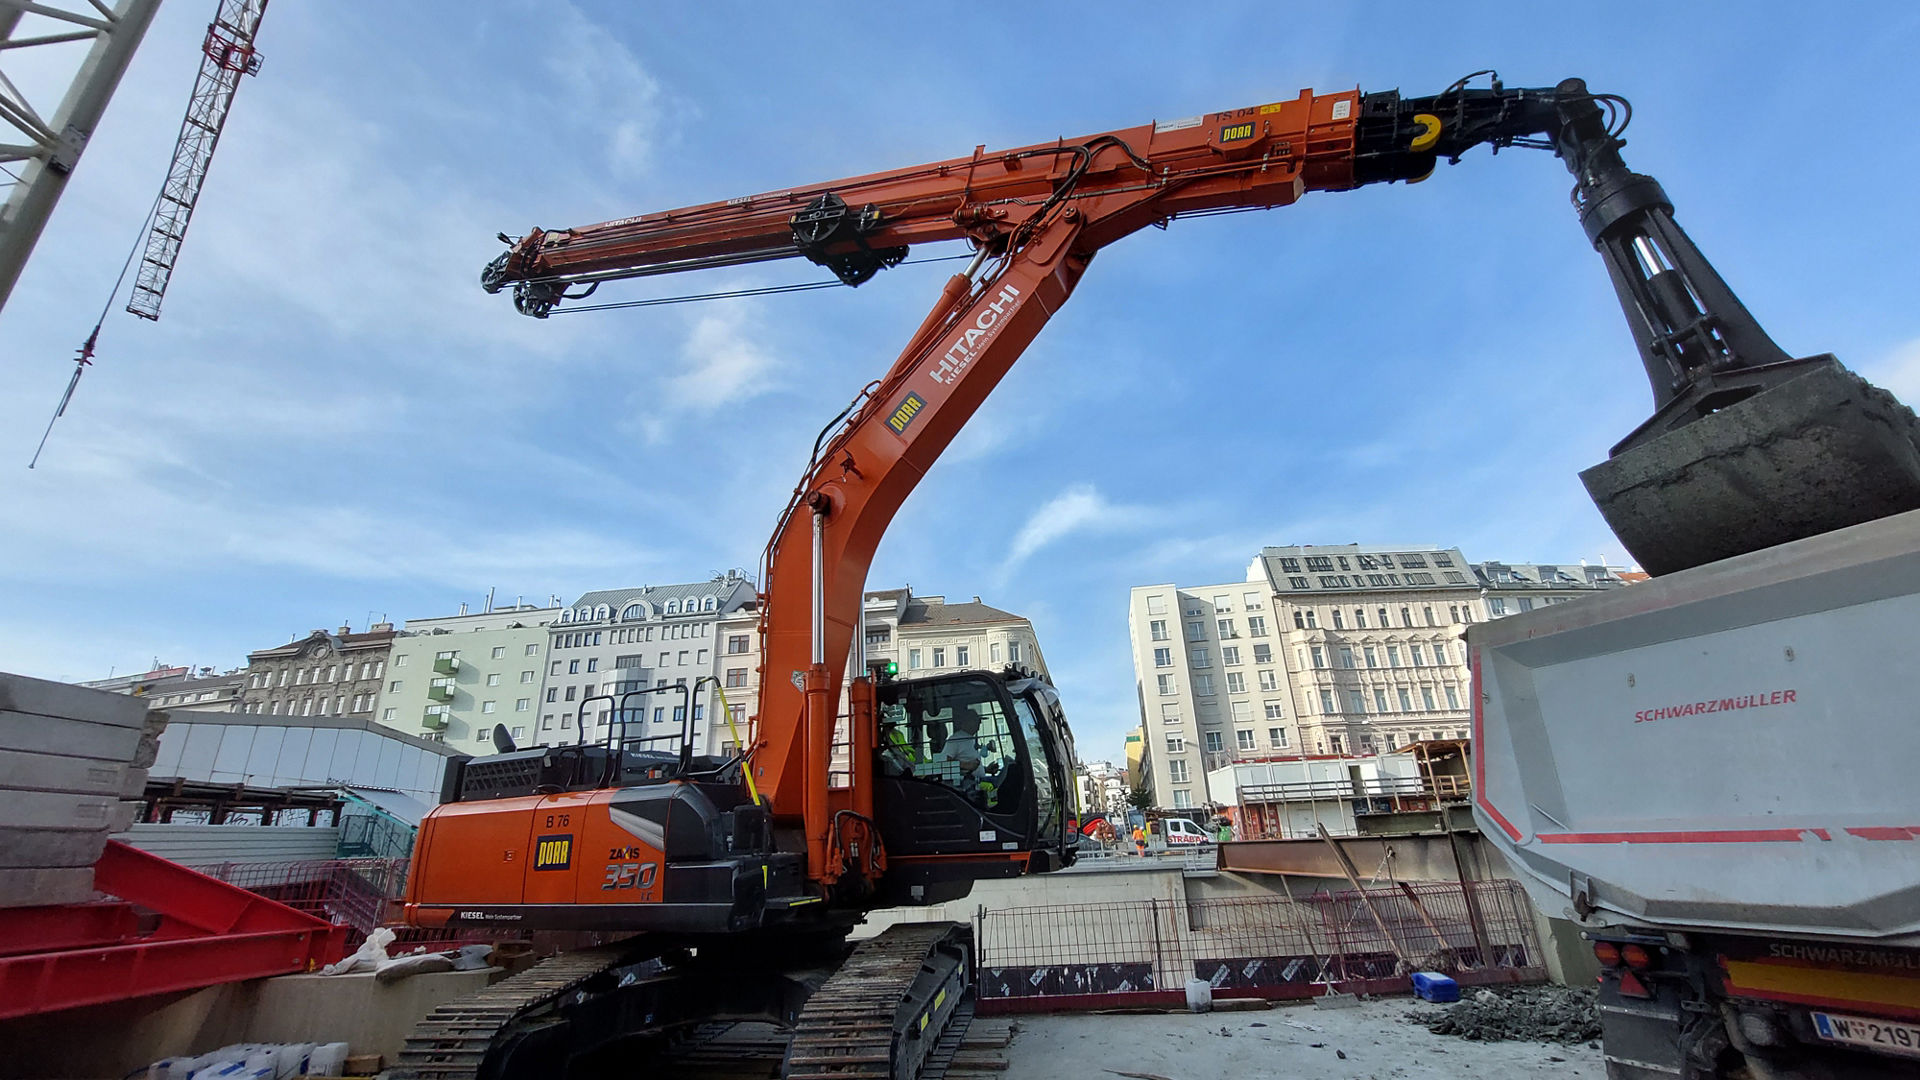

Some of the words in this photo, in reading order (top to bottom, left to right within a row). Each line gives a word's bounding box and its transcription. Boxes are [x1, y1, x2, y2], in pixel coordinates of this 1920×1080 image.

[1215, 111, 1232, 122] TS
[1237, 107, 1255, 118] 04
[929, 284, 1020, 384] HITACHI
[945, 351, 978, 385] KIESEL
[1634, 689, 1797, 724] SCHWARZMÜLLER
[546, 815, 554, 829] B
[558, 814, 570, 828] 76
[609, 847, 640, 860] ZAXIS
[601, 863, 658, 890] 350
[460, 911, 485, 920] KIESEL
[1769, 943, 1920, 970] SCHWARZMÜL
[1832, 1018, 1852, 1038] W
